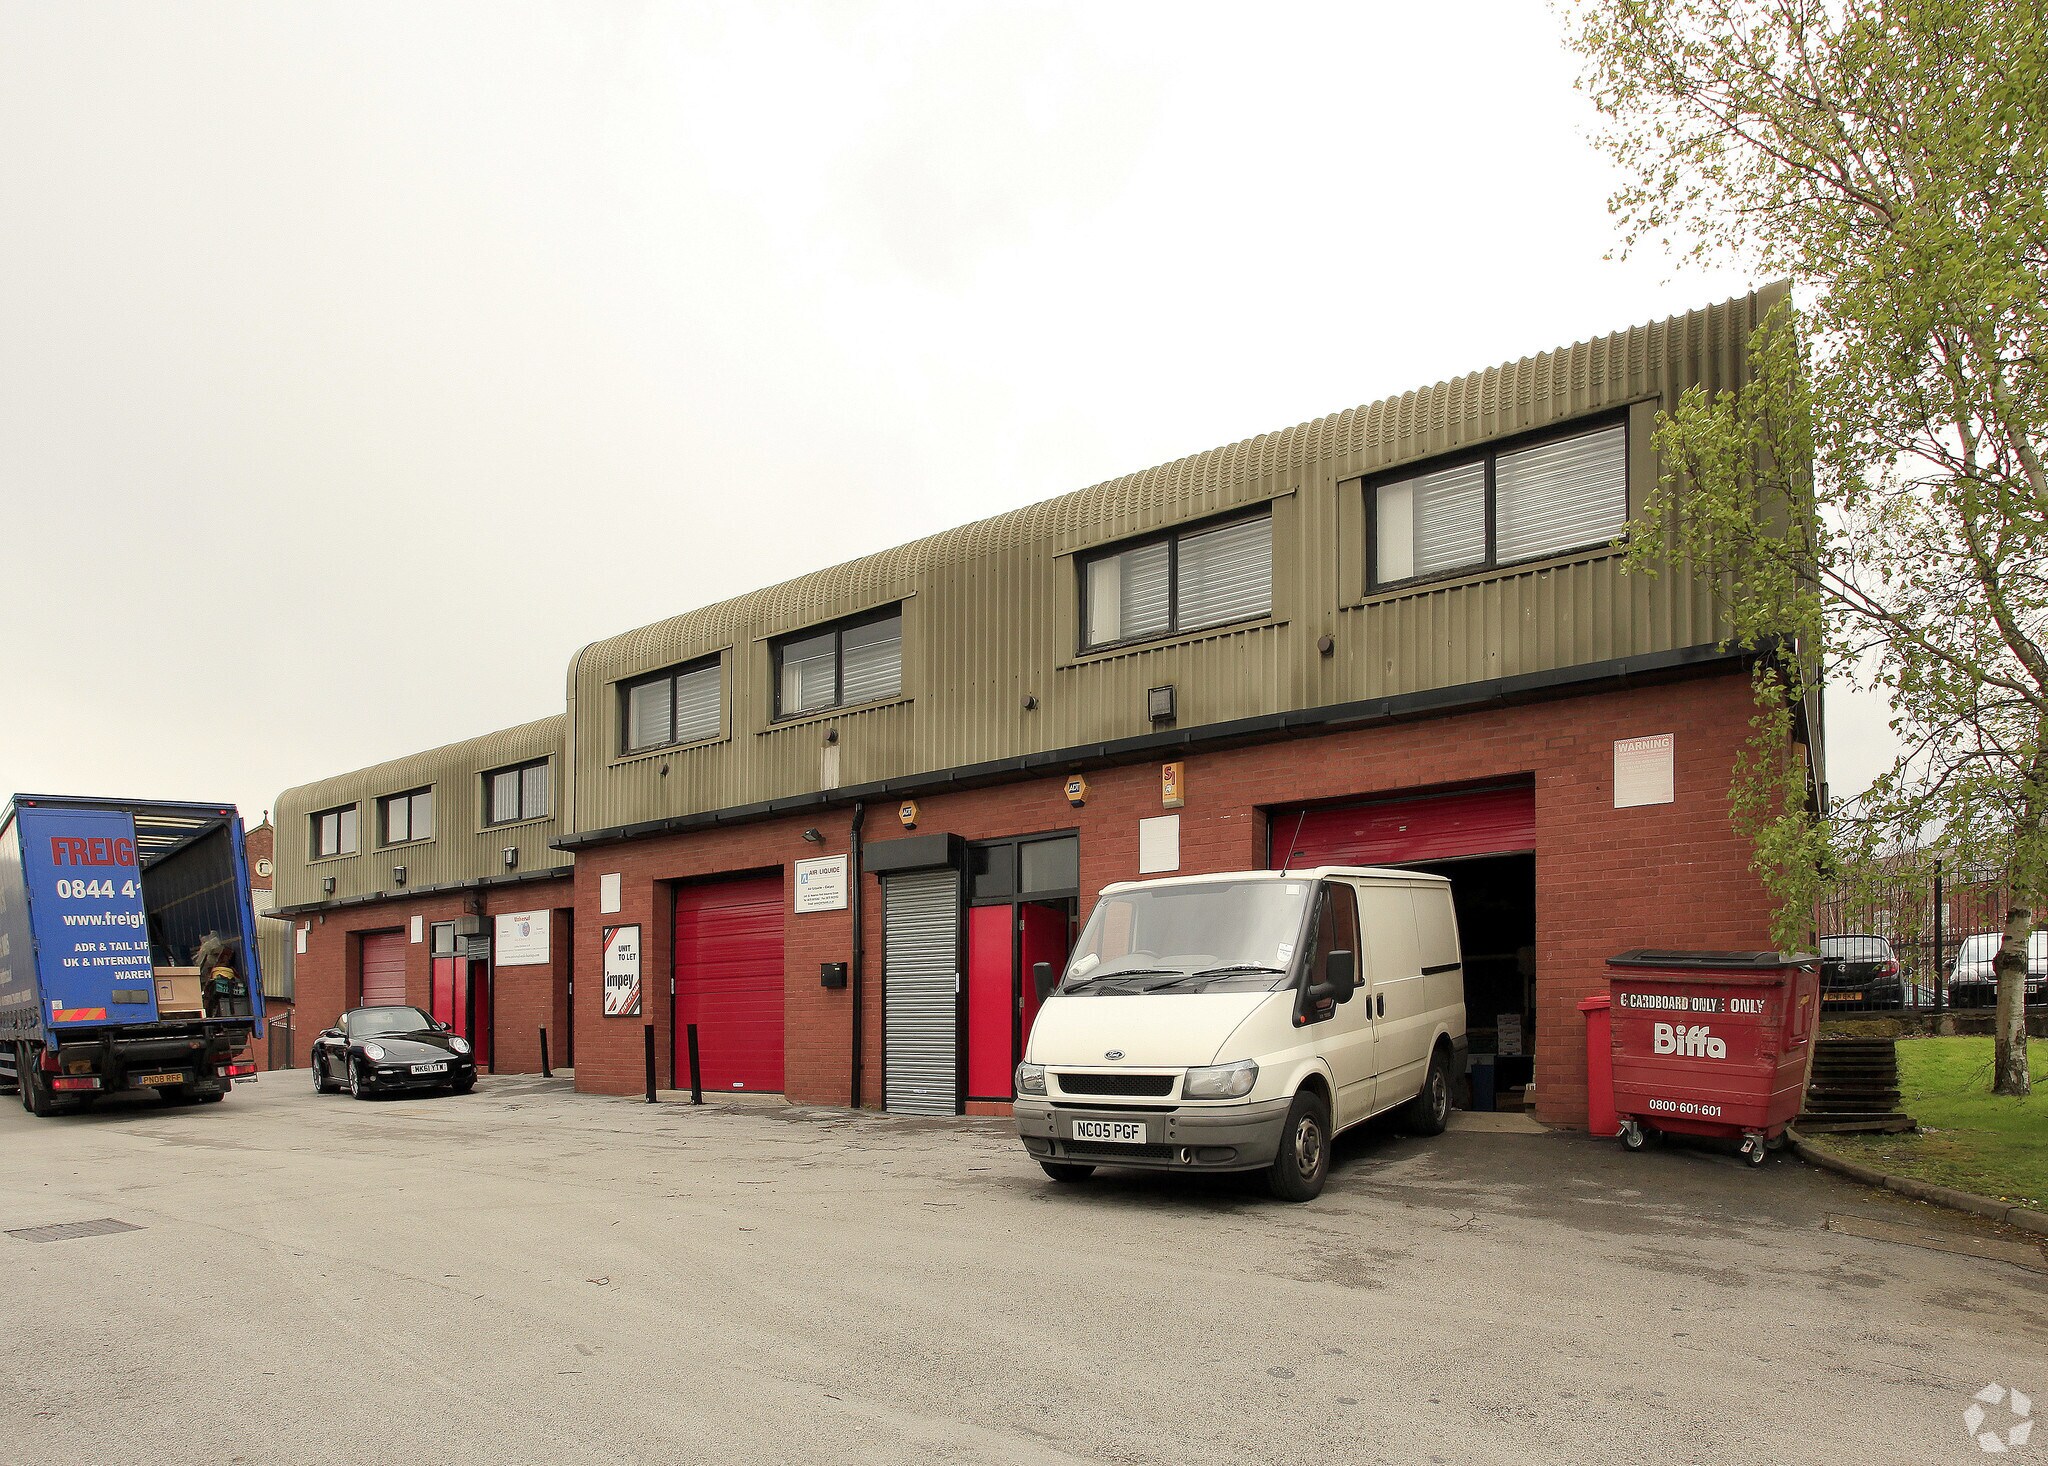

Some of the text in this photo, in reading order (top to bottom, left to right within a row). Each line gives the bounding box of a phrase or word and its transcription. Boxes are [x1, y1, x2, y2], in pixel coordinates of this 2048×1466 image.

[1618, 738, 1670, 753] WARNING
[819, 866, 840, 875] LIQUIDE
[57, 879, 142, 899] 0844 4
[74, 943, 97, 952] ADR
[99, 943, 107, 952] &
[109, 942, 132, 951] TAIL
[618, 944, 631, 953] UNIT
[63, 958, 80, 967] UK
[82, 957, 91, 967] &
[618, 953, 637, 961] TO LET
[606, 971, 634, 990] impey
[1629, 994, 1689, 1011] CARDBOARD
[1692, 997, 1717, 1012] ONLY
[1730, 998, 1765, 1014] ONLY
[1654, 1022, 1727, 1059] Biffa
[1077, 1121, 1140, 1140] NC05 PGF
